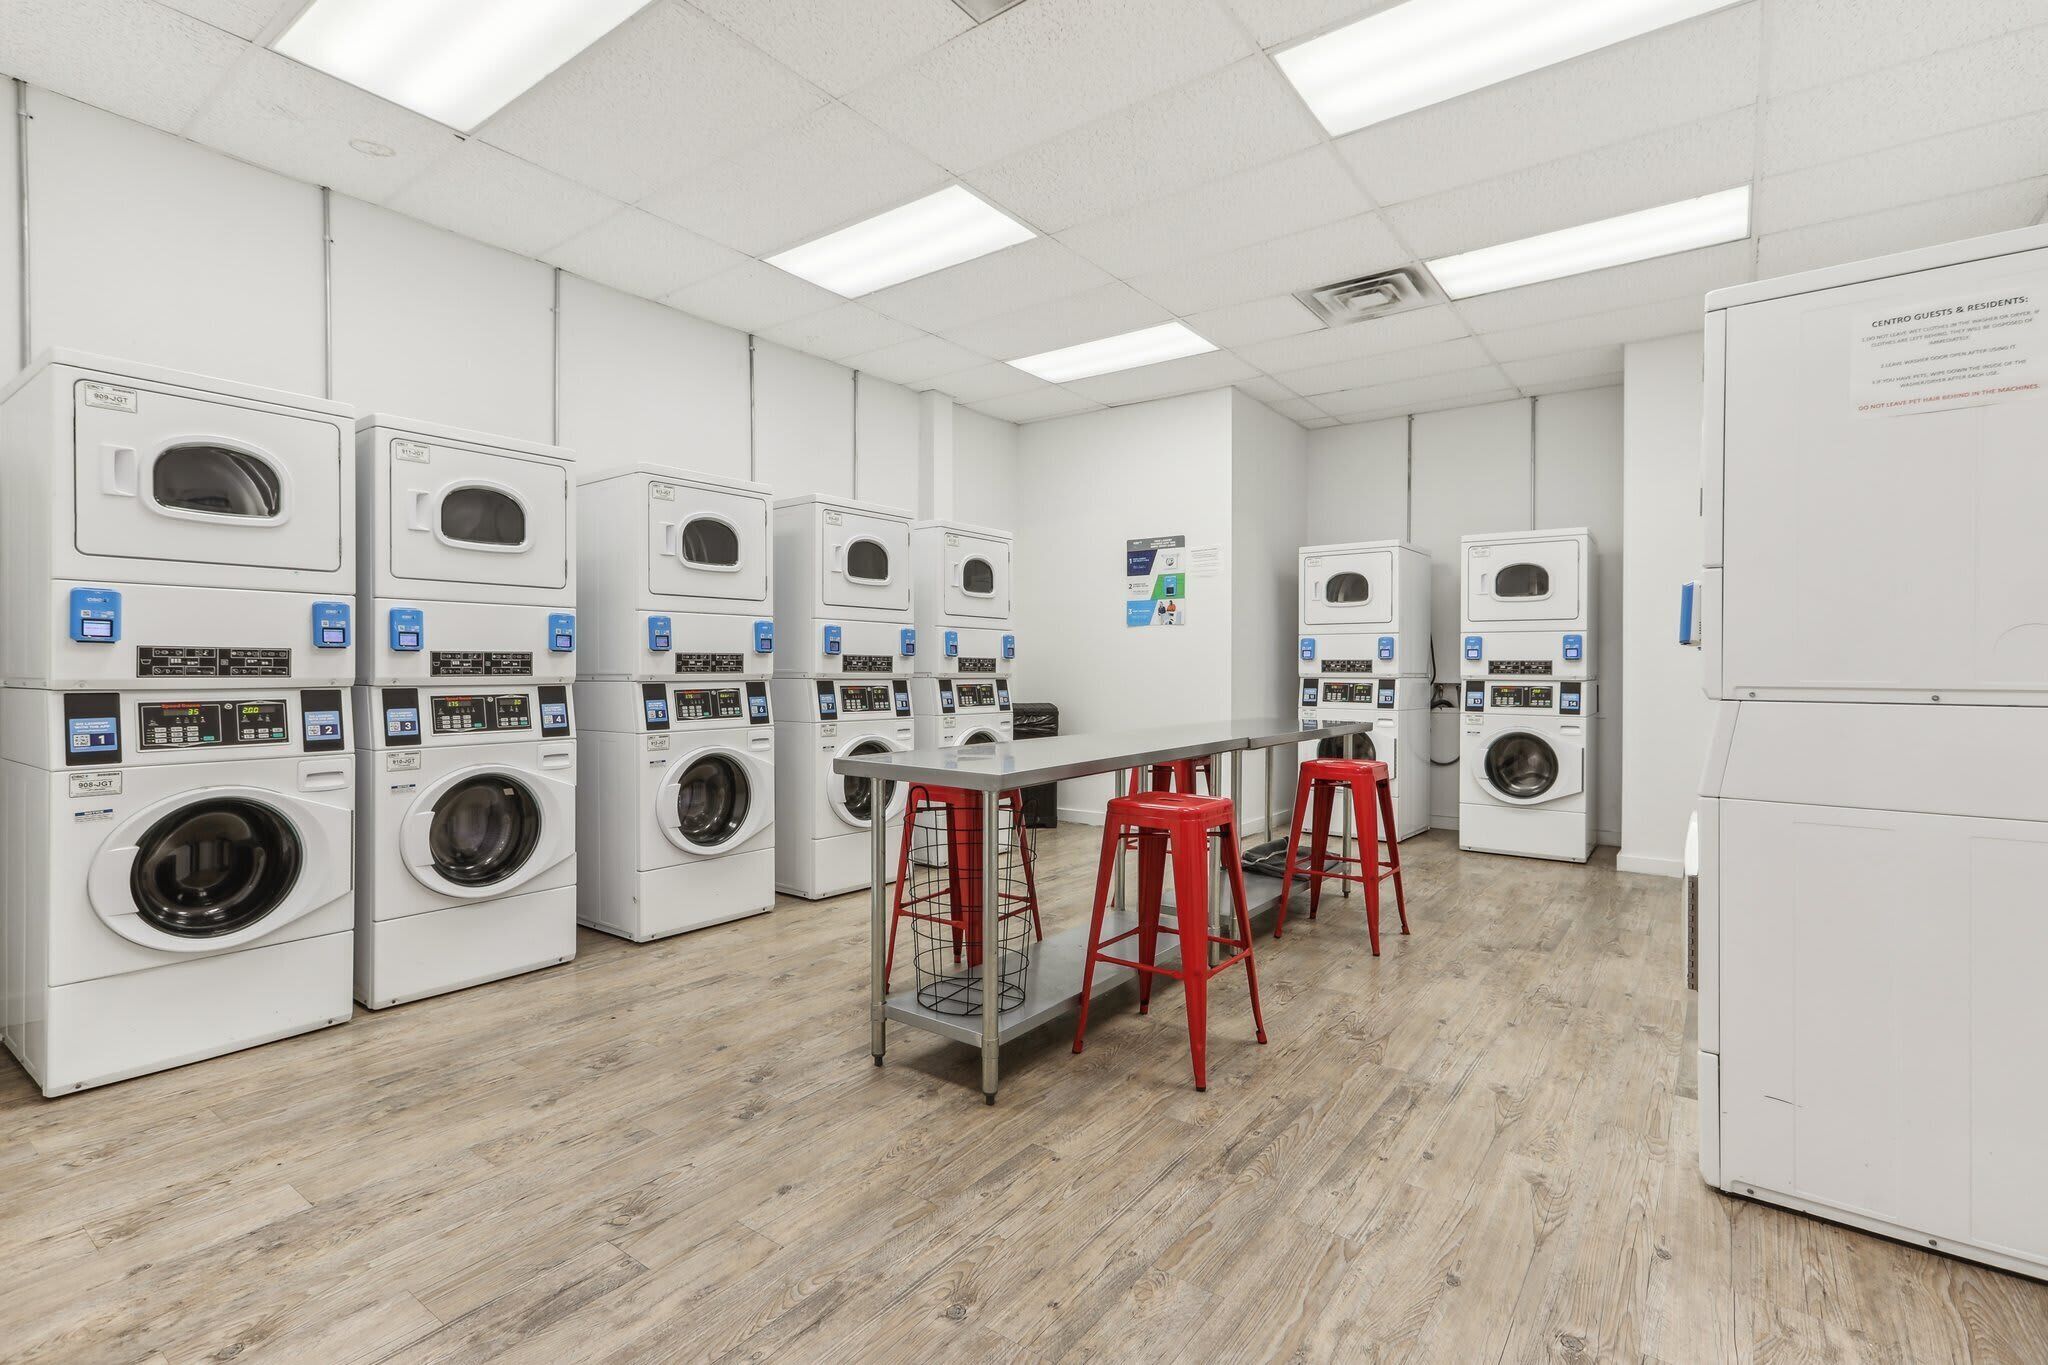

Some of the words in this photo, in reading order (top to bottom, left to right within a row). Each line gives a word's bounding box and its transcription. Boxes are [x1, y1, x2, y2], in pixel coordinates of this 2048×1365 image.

[1871, 315, 1912, 328] CENTRO
[1914, 308, 1953, 321] GUESTS
[1967, 296, 2029, 311] RESIDENTS:
[1904, 357, 1929, 365] WASHER
[1930, 353, 1948, 361] DOOR
[1886, 400, 1907, 408] LEAVE
[1942, 392, 1970, 400] BEHIND
[1997, 383, 2041, 393] MACHINES.
[188, 708, 200, 716] 35
[325, 725, 333, 734] 2
[404, 722, 412, 730] 3
[98, 735, 106, 745] 1
